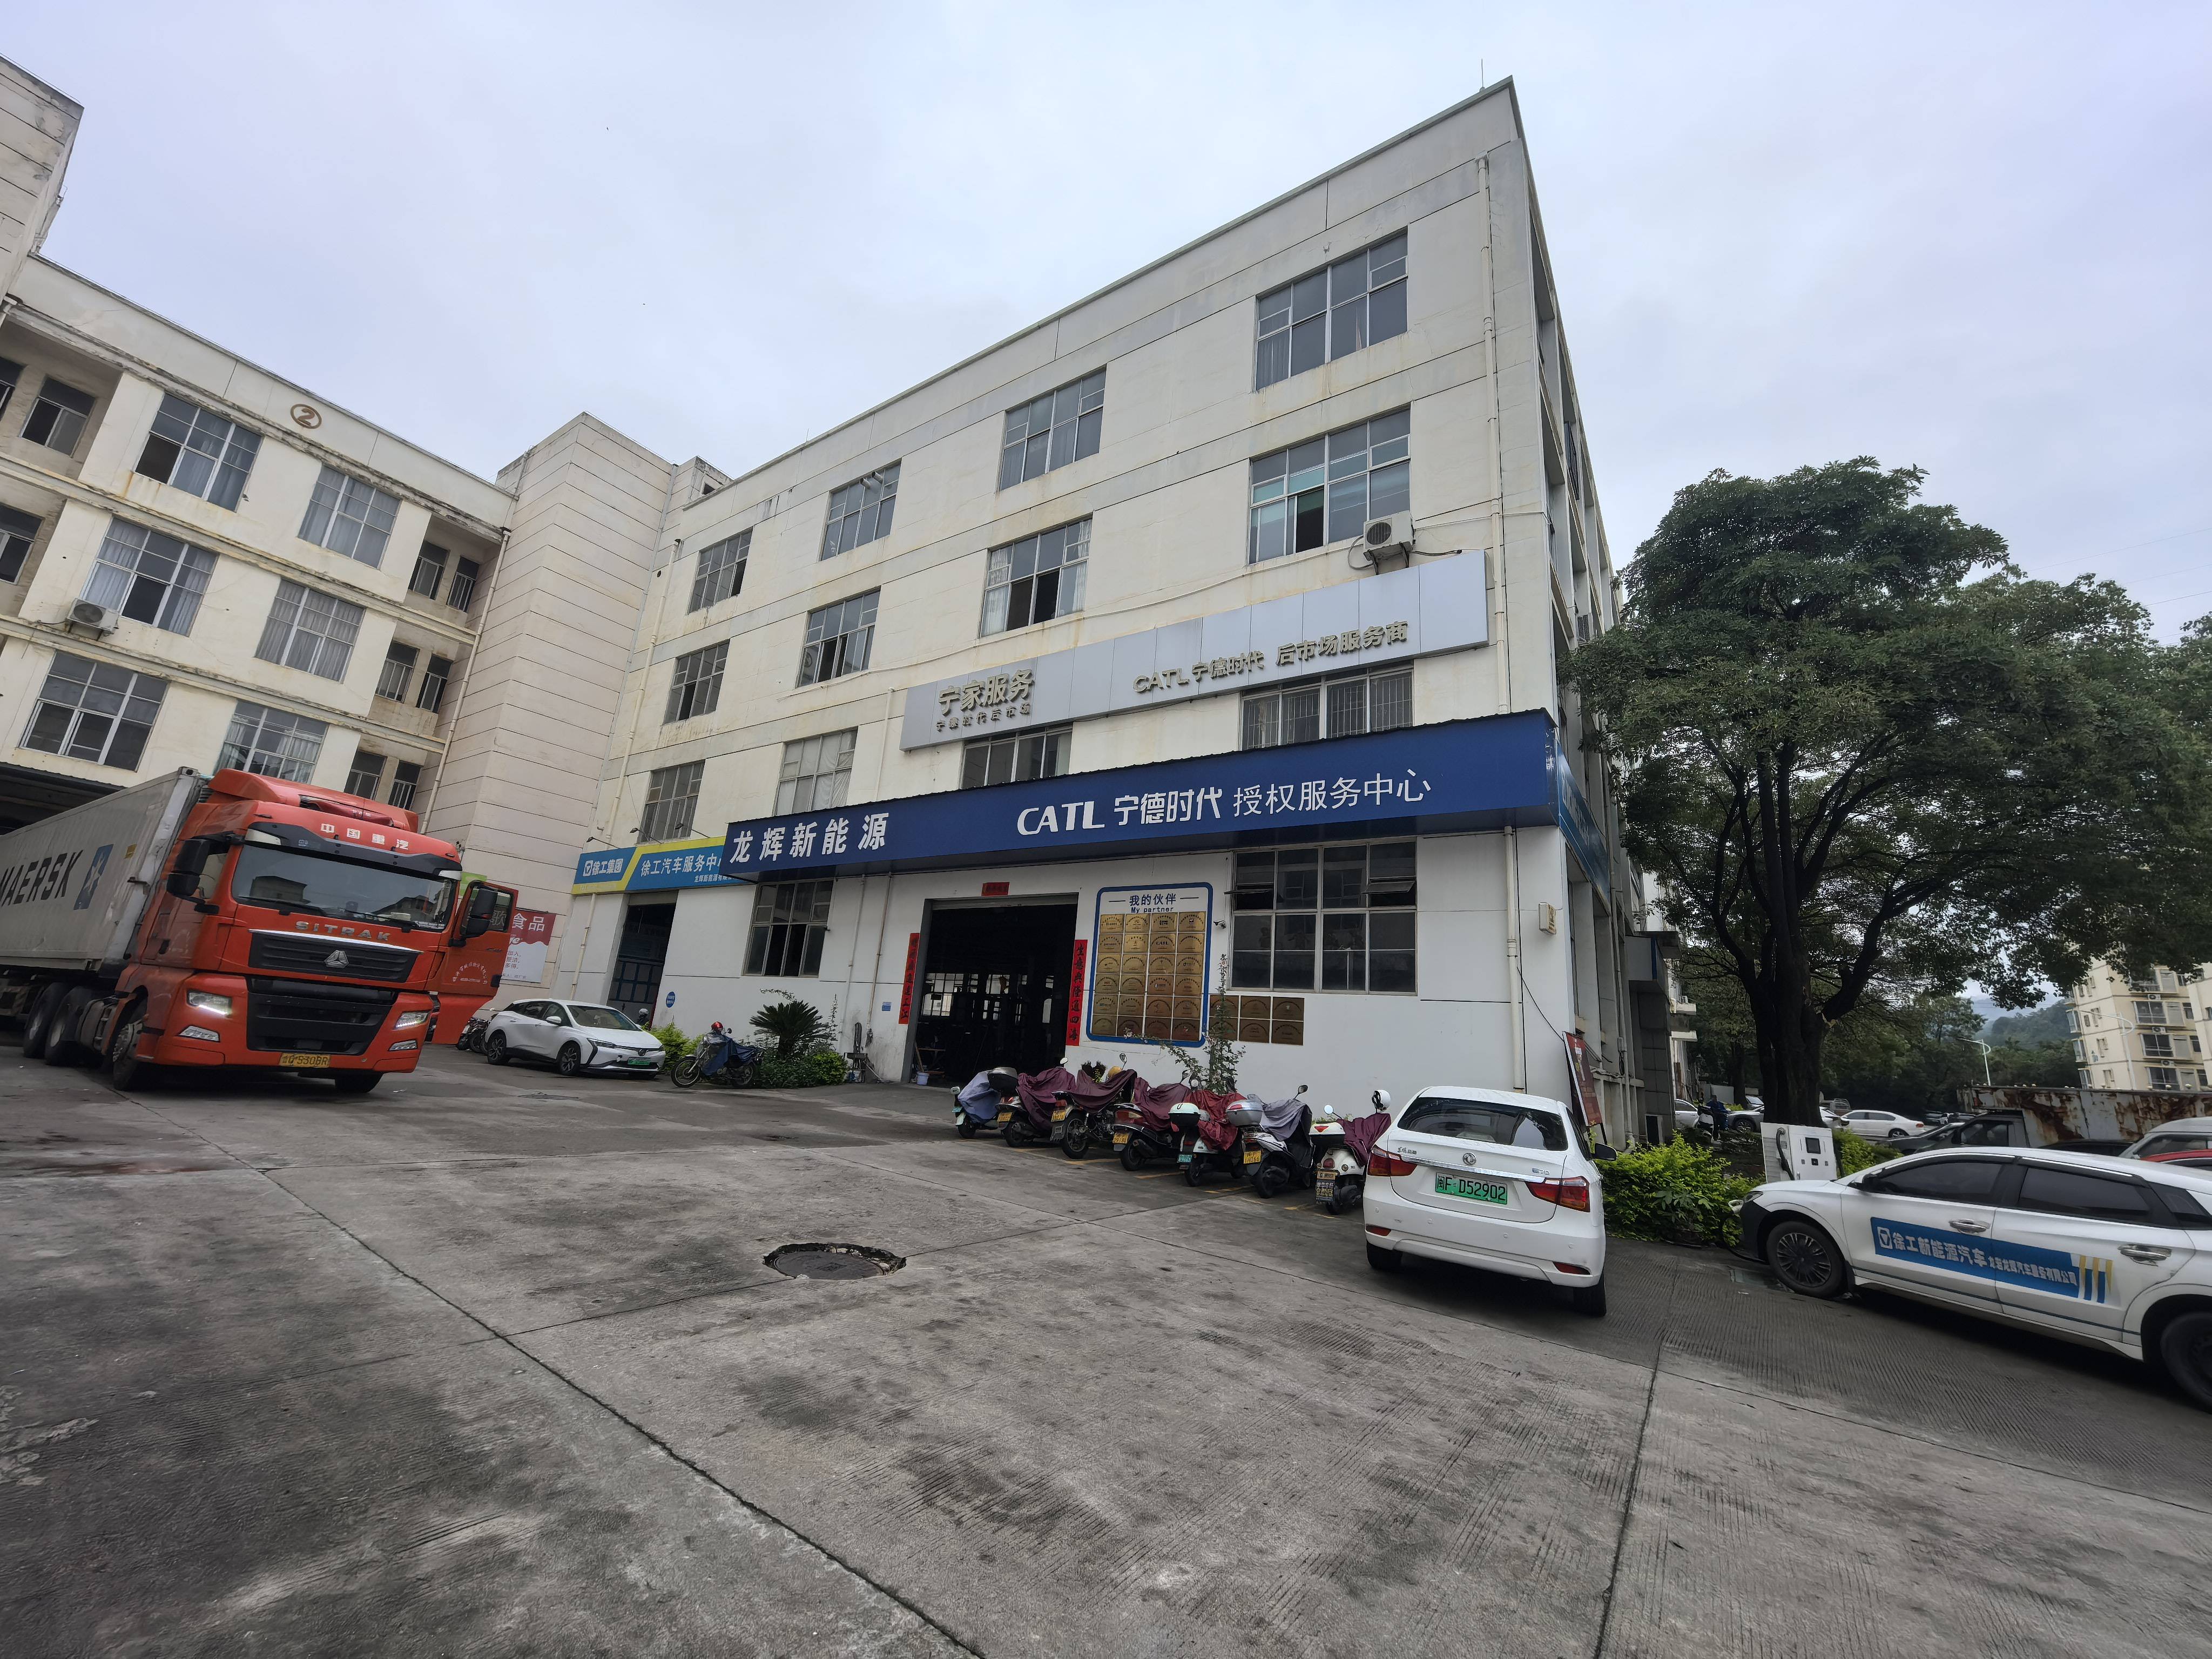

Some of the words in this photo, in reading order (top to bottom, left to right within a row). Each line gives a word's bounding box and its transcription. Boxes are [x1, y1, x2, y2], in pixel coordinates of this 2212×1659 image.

[1133, 667, 1189, 693] CATL
[1191, 650, 1265, 682] 宁德时代
[1276, 621, 1409, 666] 后市场服务商
[939, 669, 1035, 717] 宁家服务
[1017, 800, 1105, 835] CATL
[1114, 787, 1223, 826] 宁德时代
[1233, 768, 1432, 817] 授权服务中心
[730, 813, 889, 864] 龙辉新能源
[592, 859, 623, 875] 徐工集团
[1129, 893, 1176, 906] 我的伙伴
[295, 921, 391, 941] SITRAK
[512, 913, 544, 932] 食品
[1893, 1232, 1987, 1267] 徐工新能源汽车
